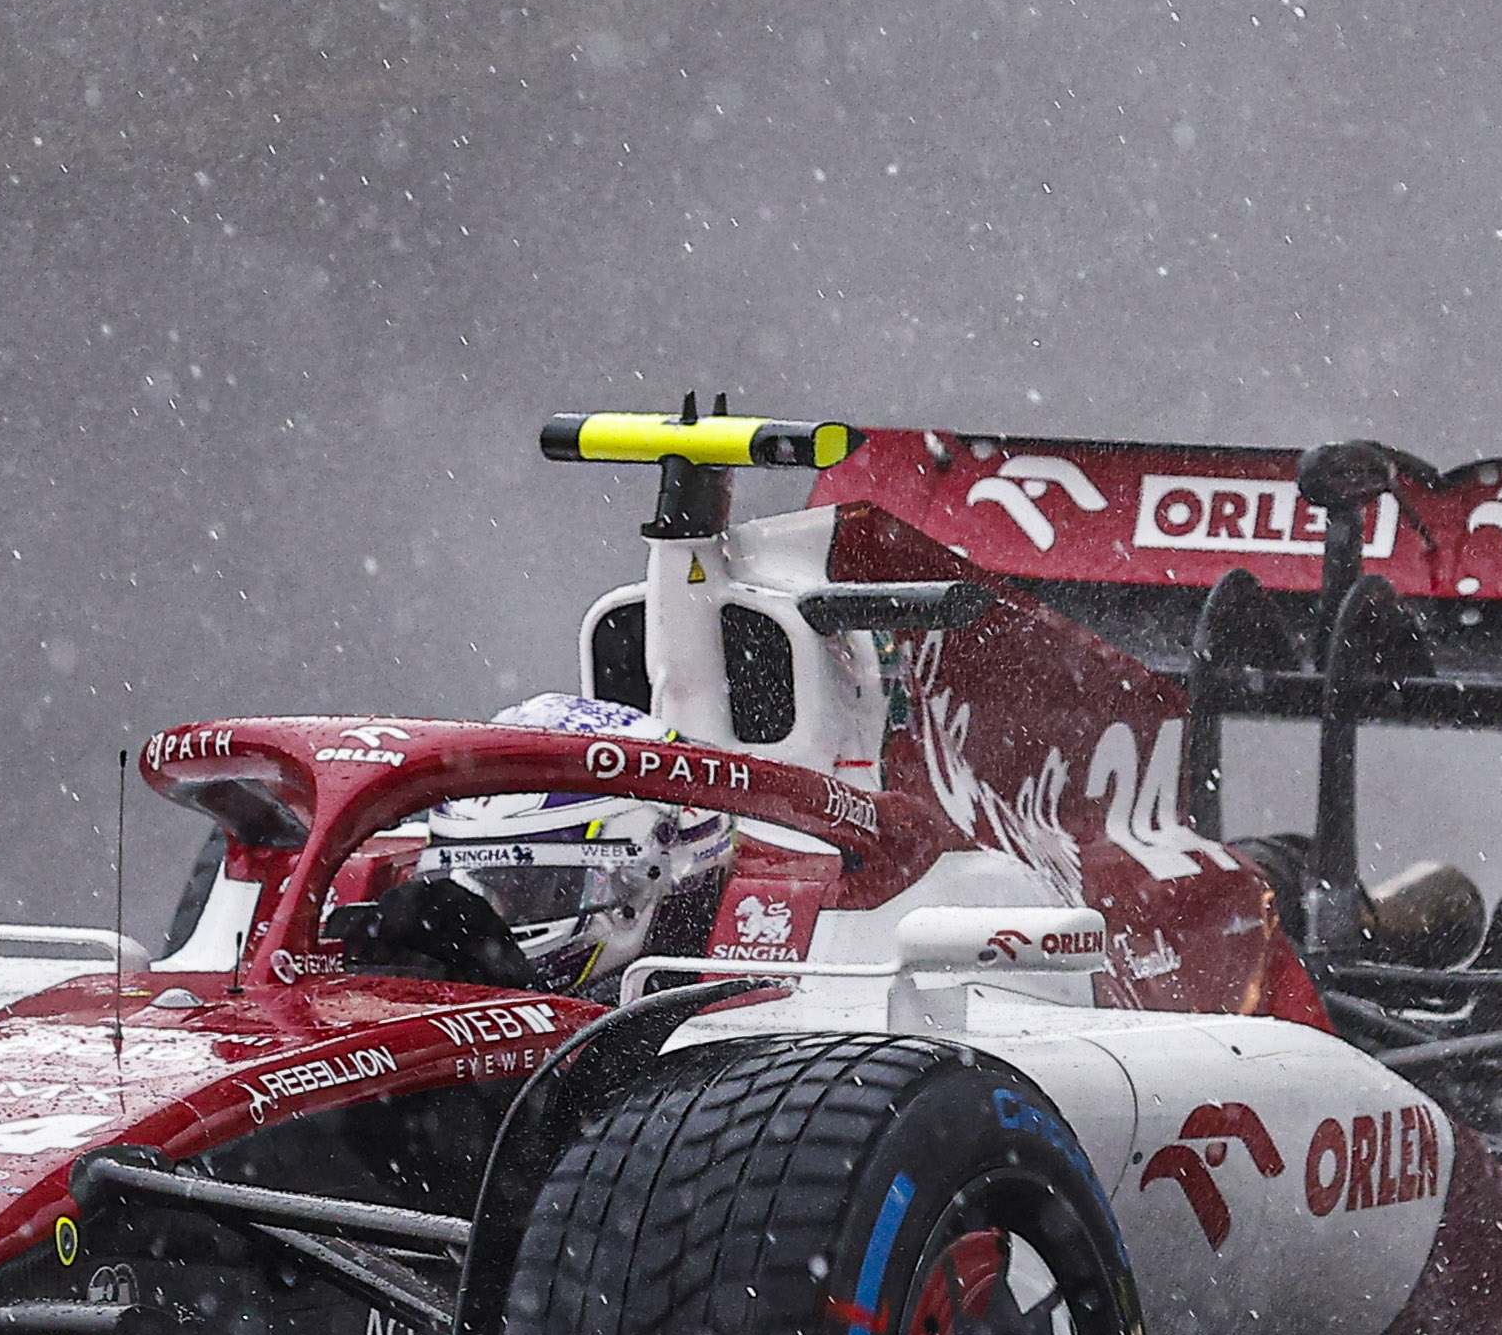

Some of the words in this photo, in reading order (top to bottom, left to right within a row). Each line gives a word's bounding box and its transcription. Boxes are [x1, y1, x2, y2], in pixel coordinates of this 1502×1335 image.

[163, 729, 233, 763] PATH
[315, 748, 405, 767] ORLEN
[639, 751, 750, 791] PATH
[1087, 718, 1240, 881] 24
[454, 847, 509, 863] SINGHA
[581, 843, 624, 859] WEB
[712, 943, 799, 962] SINGHA
[1041, 931, 1104, 955] ORLEN
[428, 1009, 526, 1047] WEB
[457, 1048, 554, 1079] EYEWE
[1304, 1103, 1439, 1217] ORLEN
